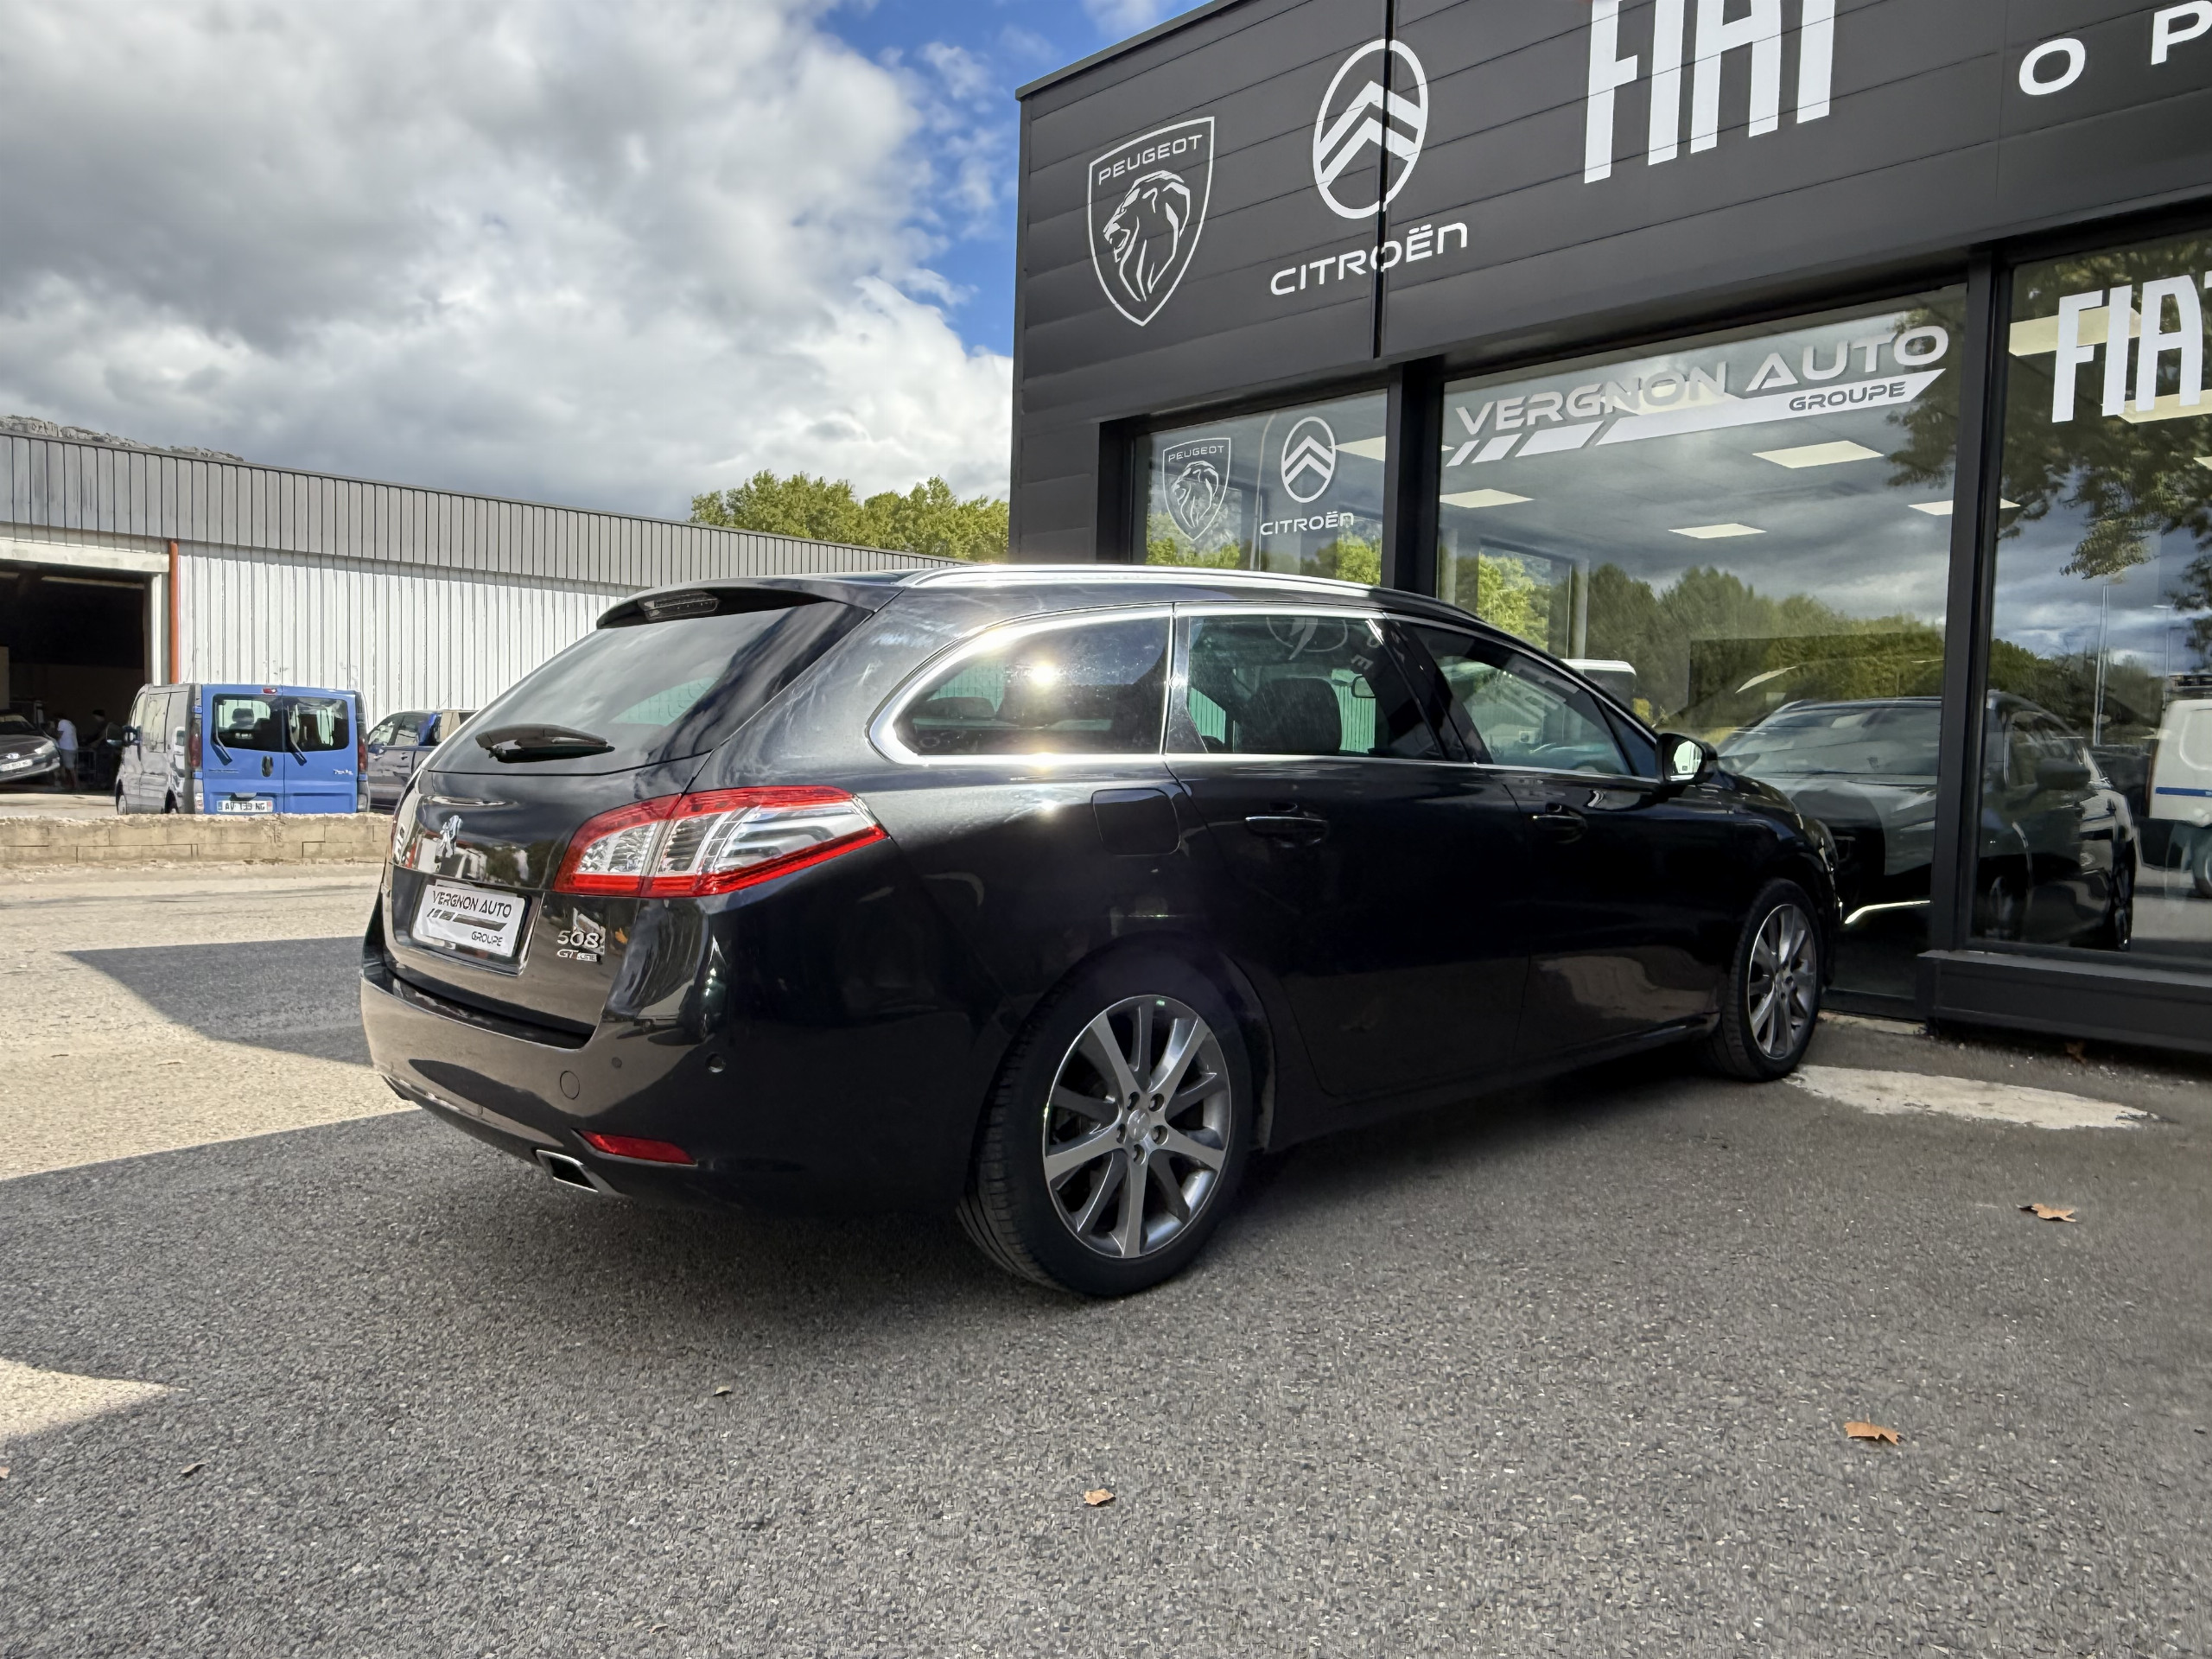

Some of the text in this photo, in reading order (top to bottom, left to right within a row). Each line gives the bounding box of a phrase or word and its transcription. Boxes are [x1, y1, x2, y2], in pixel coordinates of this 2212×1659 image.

[1098, 134, 1203, 186] PEUGEOT
[1270, 222, 1468, 296] CITROËN
[2052, 270, 2212, 423] FIA
[1455, 325, 1948, 435] VERGNON AUTO
[1789, 380, 1906, 411] GROUPE
[1168, 445, 1224, 462] PEUGEOT
[1260, 511, 1354, 536] CITROËN
[433, 890, 512, 918] VERGNON AUTO
[471, 931, 503, 947] GROUPE
[557, 931, 600, 949] 508
[556, 949, 579, 959] GT
